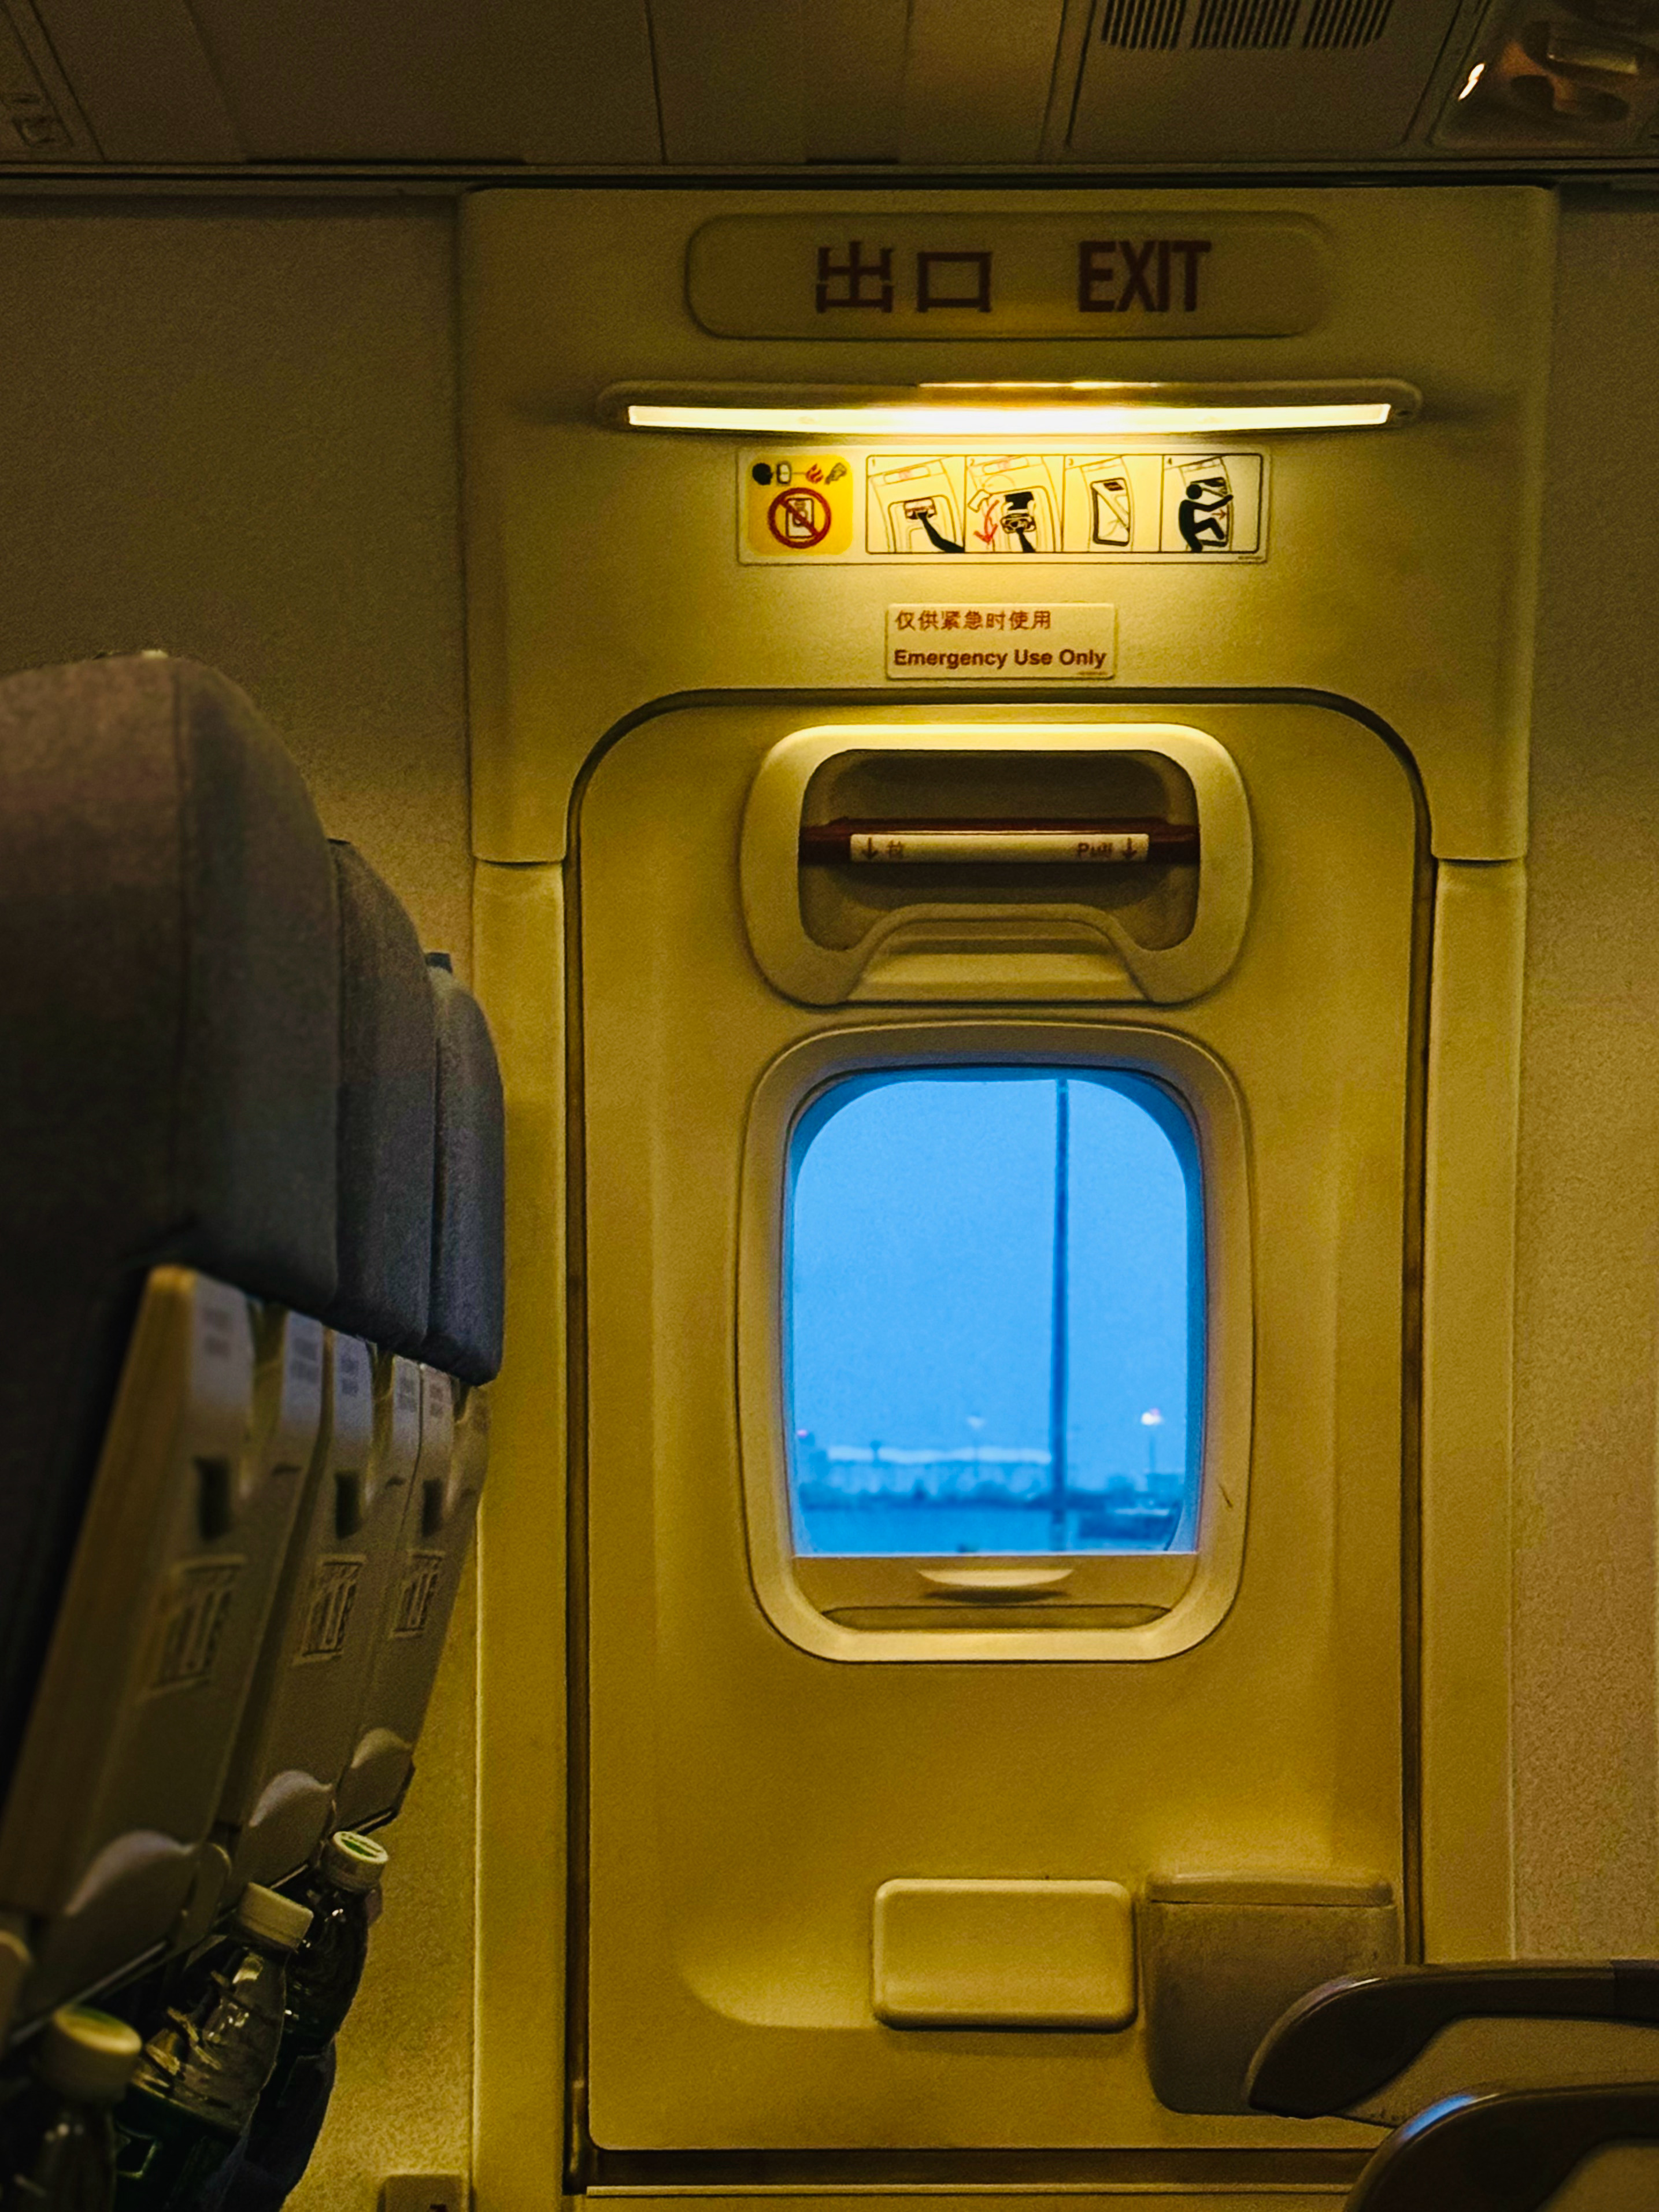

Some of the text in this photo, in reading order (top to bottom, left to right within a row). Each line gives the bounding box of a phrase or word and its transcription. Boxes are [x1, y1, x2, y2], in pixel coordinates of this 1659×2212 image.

[816, 240, 1212, 313] 出口 EXIT
[895, 610, 1051, 631] 仅供紧急时使用
[893, 648, 1107, 670] Emergency Use Only
